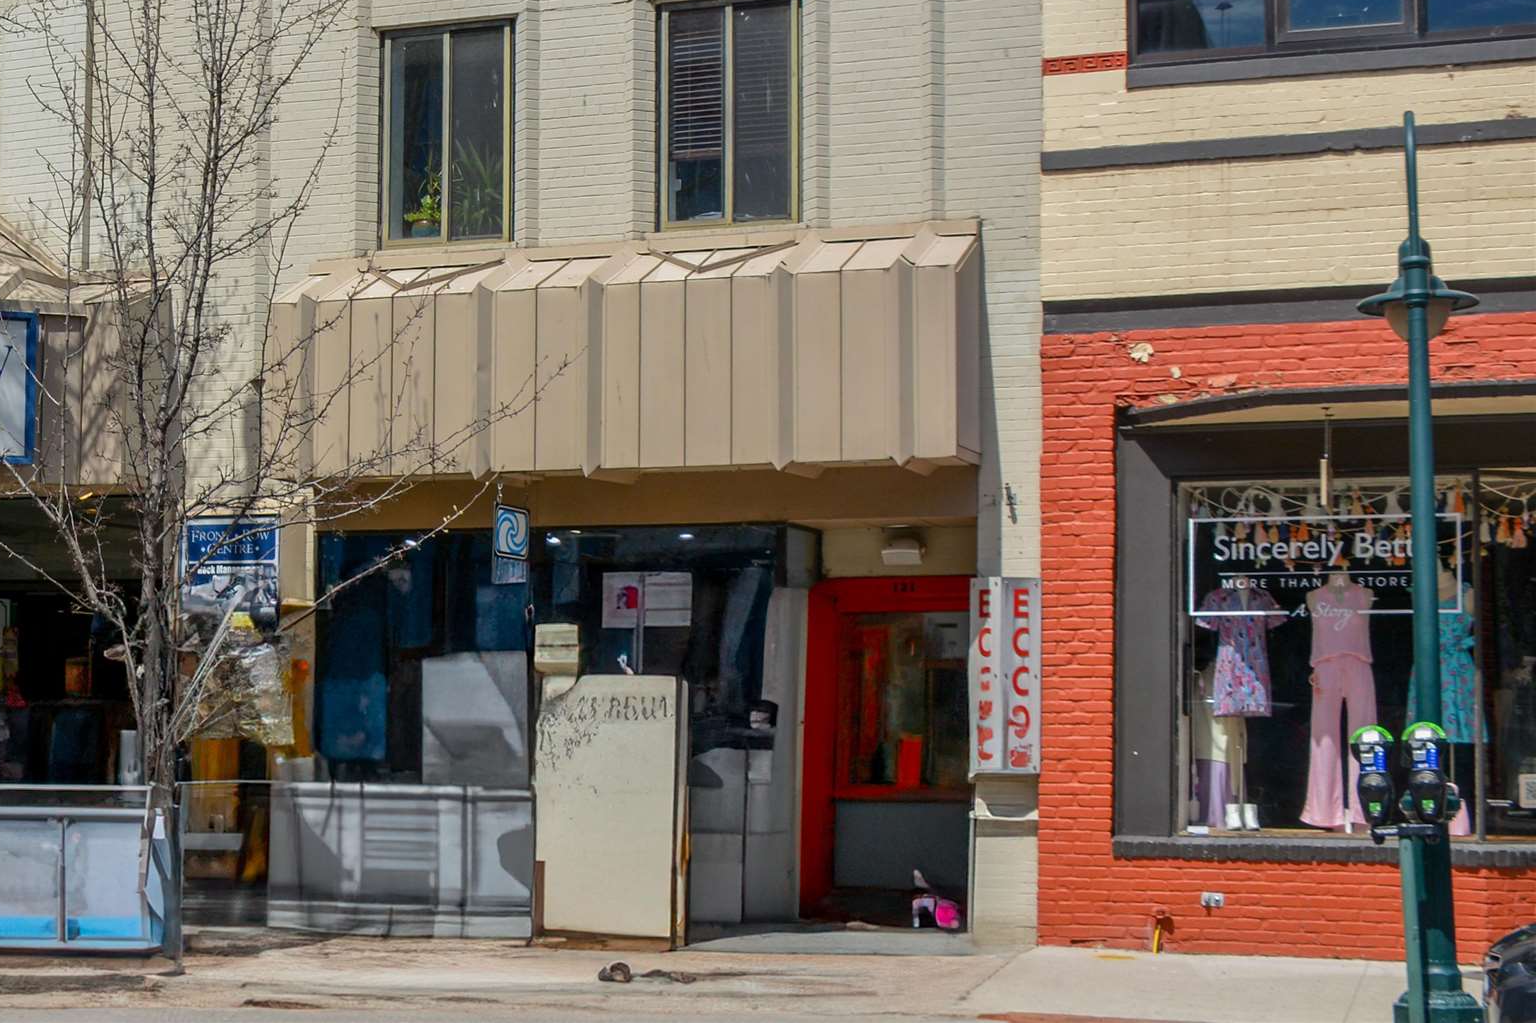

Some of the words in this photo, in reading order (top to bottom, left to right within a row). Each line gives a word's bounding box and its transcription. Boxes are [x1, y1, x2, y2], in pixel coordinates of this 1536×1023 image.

[1214, 533, 1344, 566] Sincerely
[1221, 577, 1268, 590] MORE
[1279, 577, 1322, 588] THAN
[1333, 577, 1345, 587] A
[1290, 603, 1308, 618] A
[1311, 602, 1354, 630] Story
